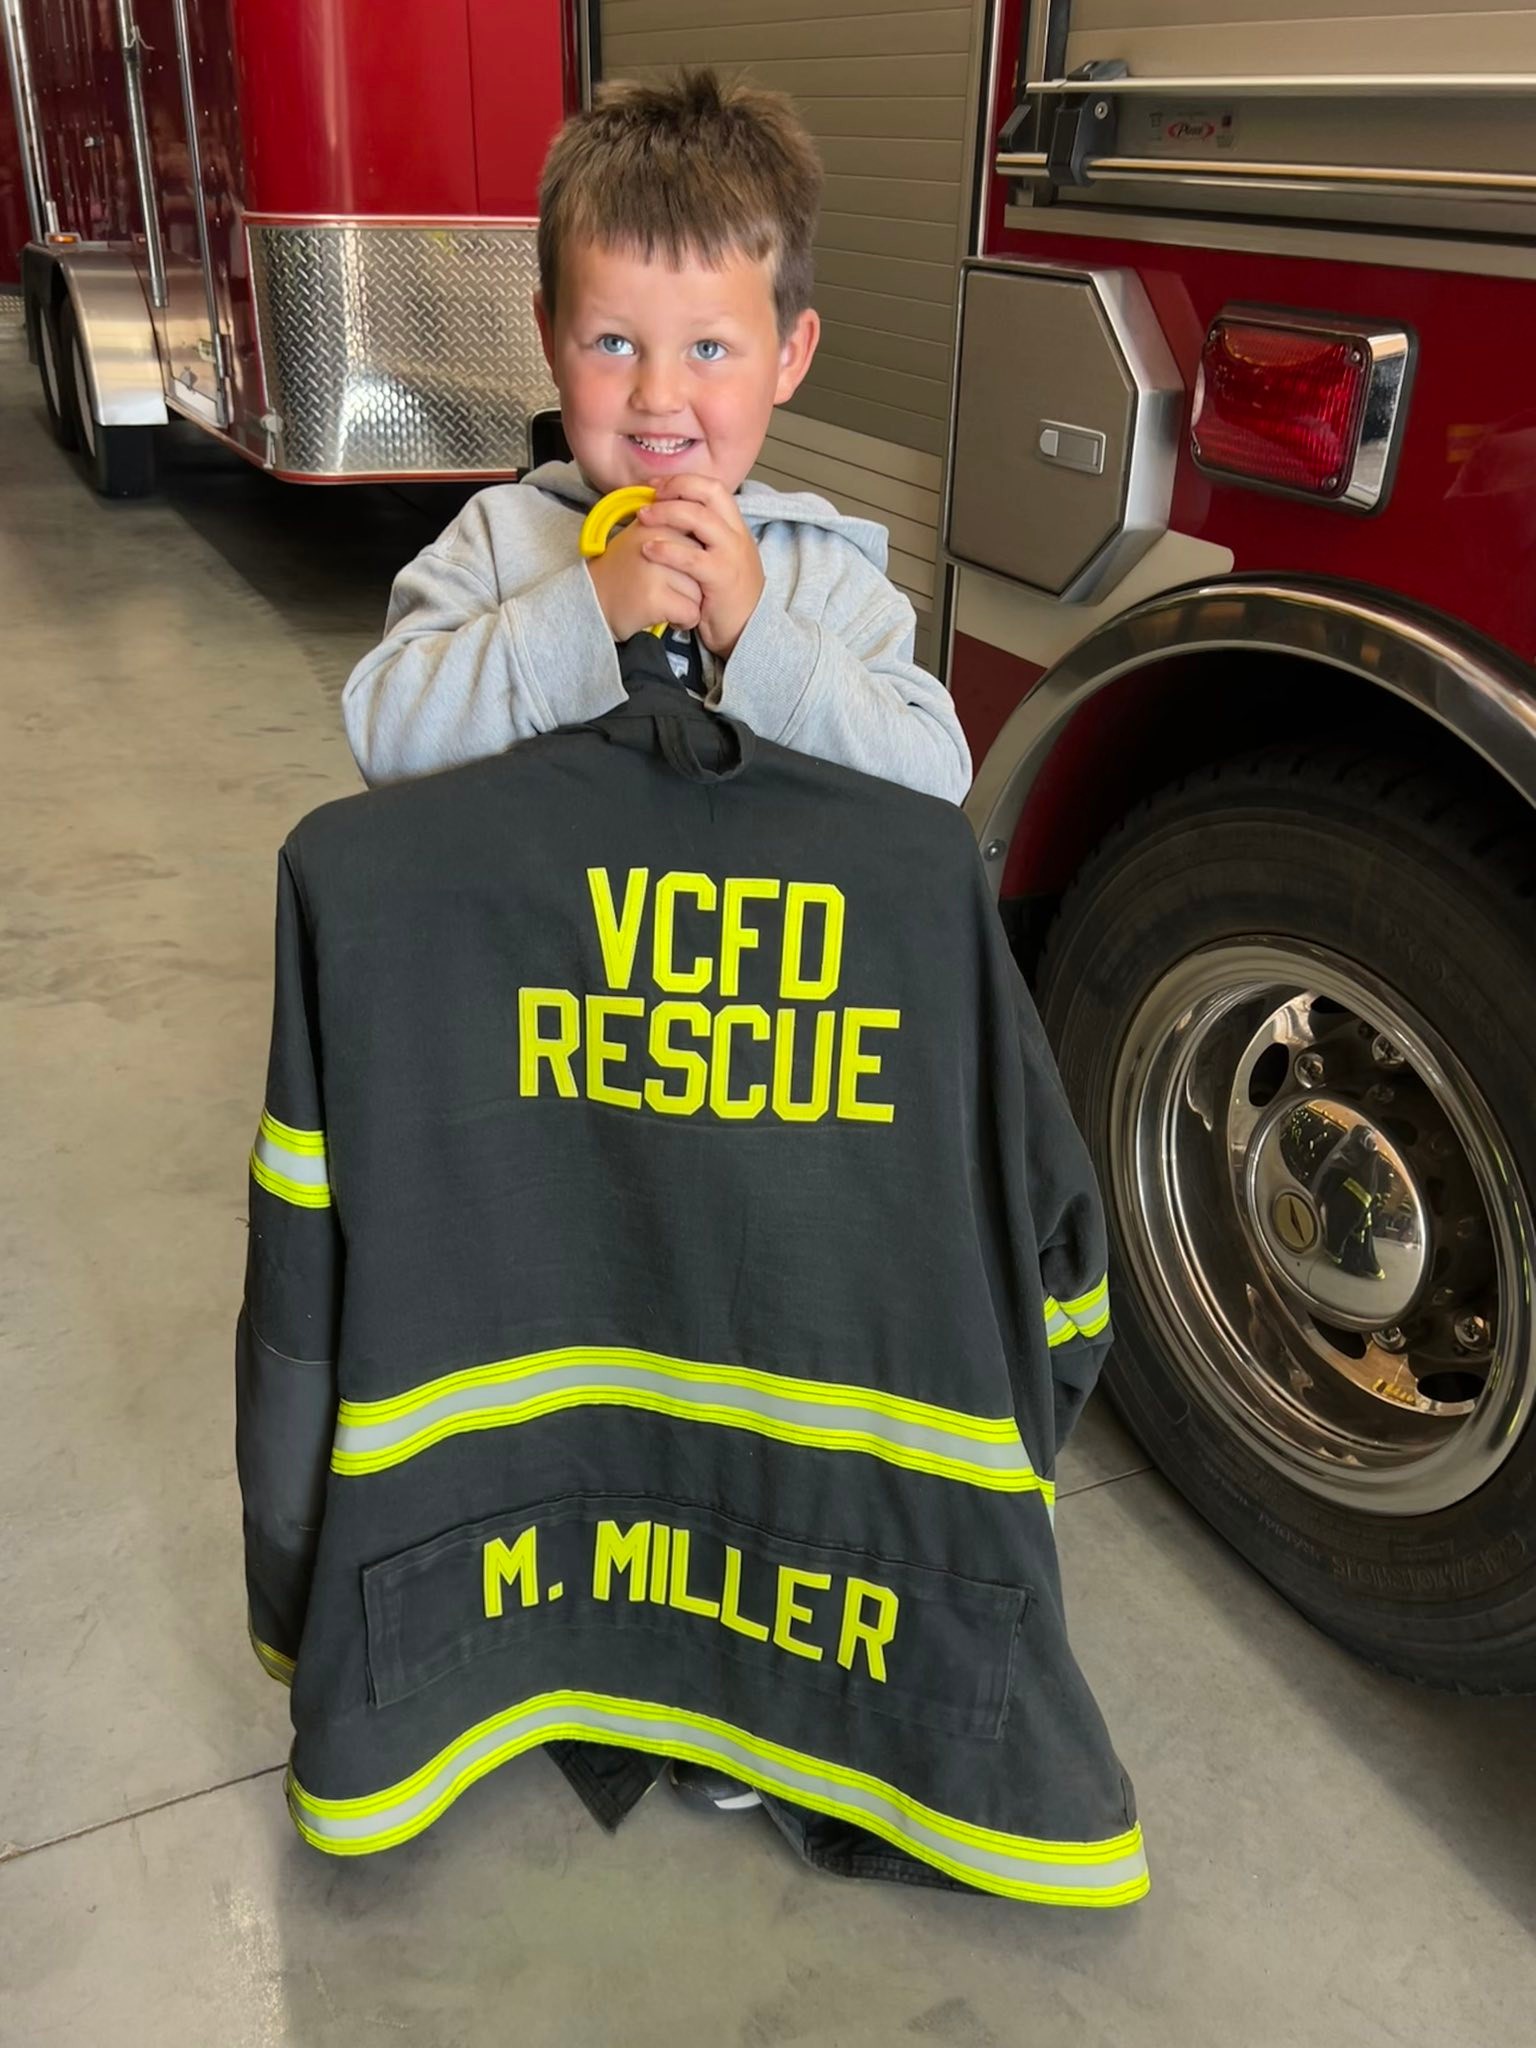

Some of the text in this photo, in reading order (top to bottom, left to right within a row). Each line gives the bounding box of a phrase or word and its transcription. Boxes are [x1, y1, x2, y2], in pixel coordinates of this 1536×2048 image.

[587, 868, 845, 1000] VCFD
[518, 988, 900, 1122] RESCUE
[482, 1519, 900, 1683] M. MILLER
